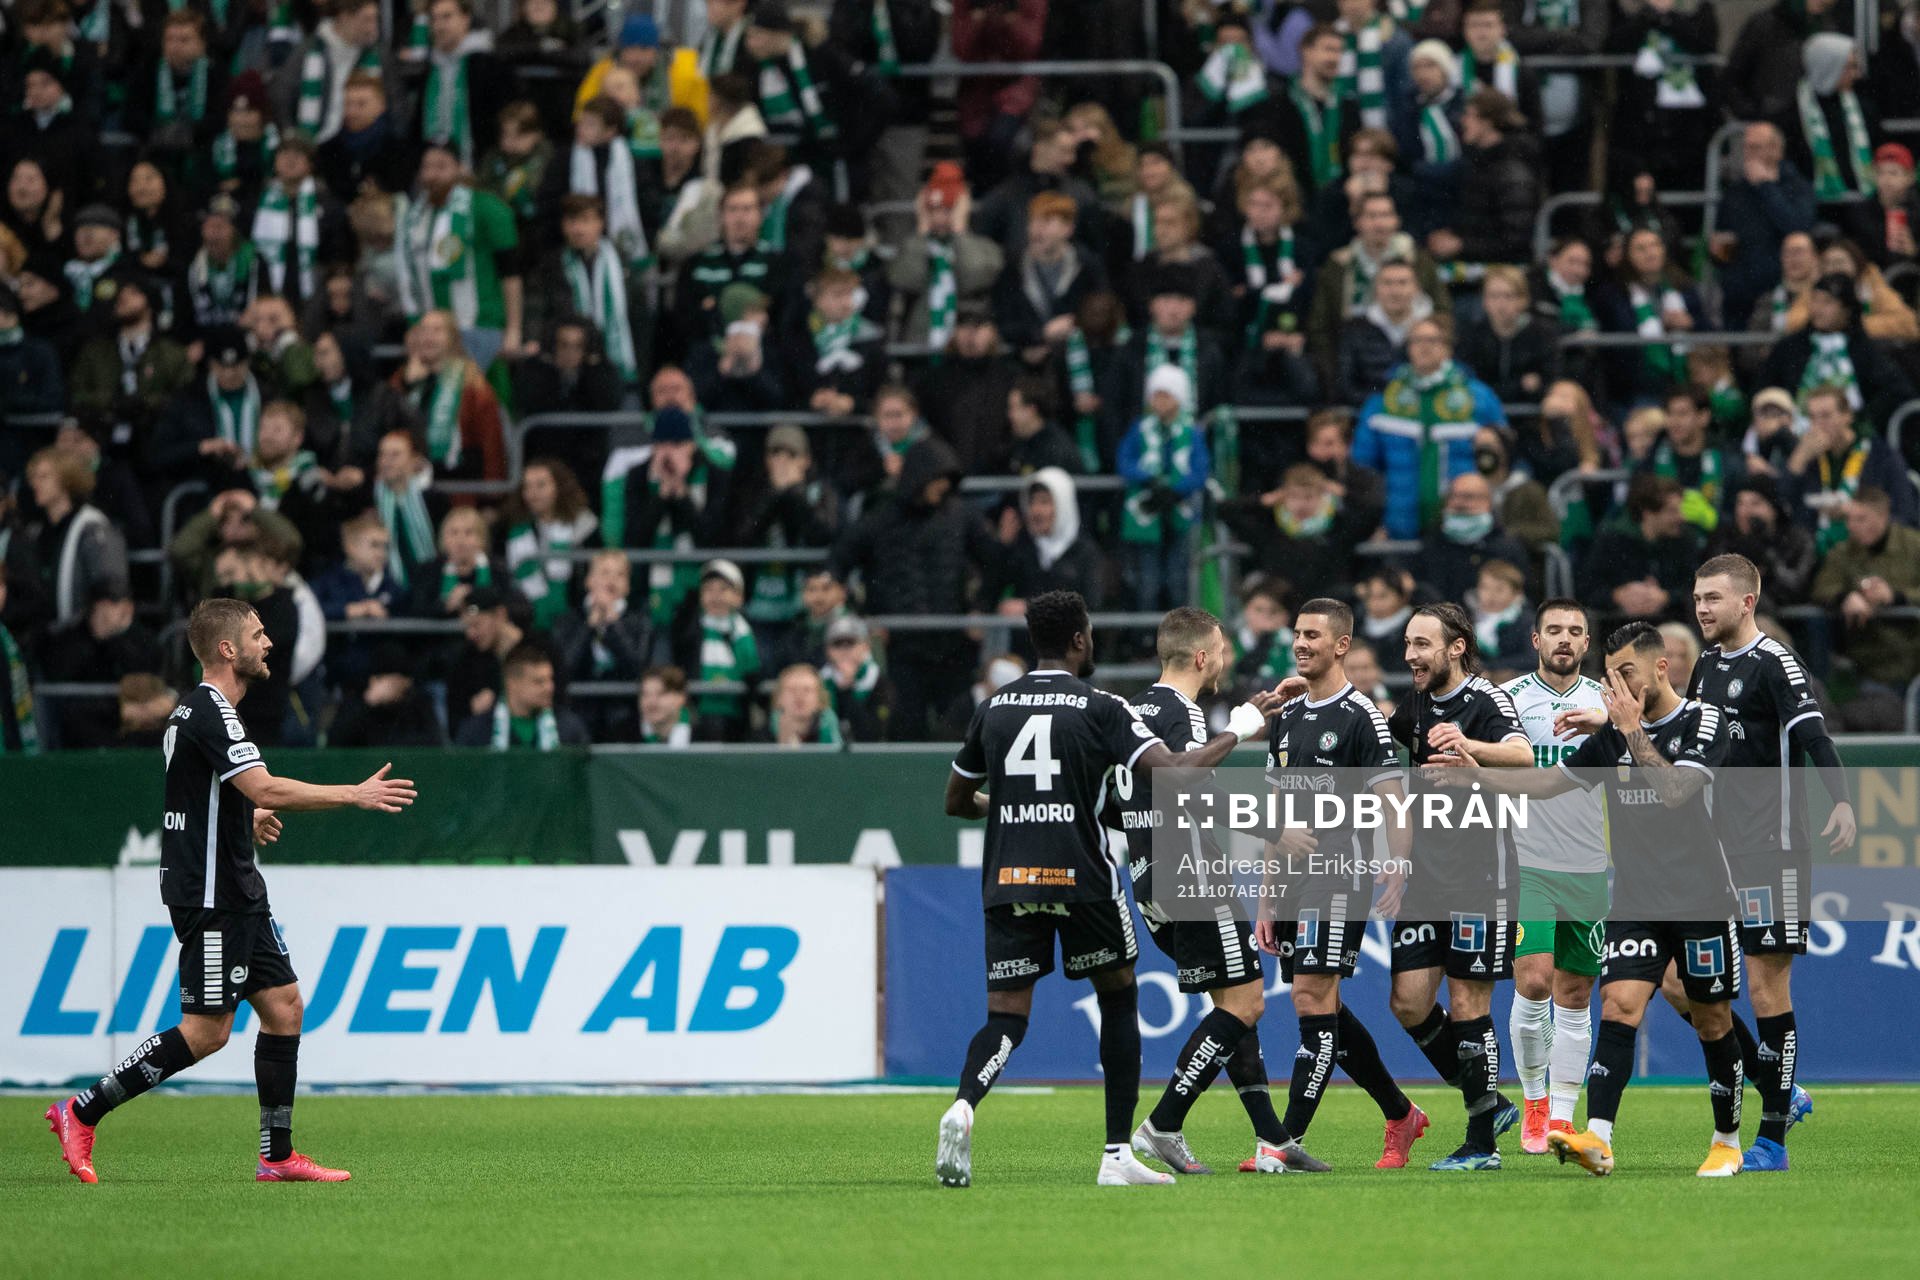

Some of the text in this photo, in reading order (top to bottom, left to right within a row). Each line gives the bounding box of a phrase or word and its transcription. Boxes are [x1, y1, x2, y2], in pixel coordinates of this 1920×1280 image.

[989, 693, 1088, 709] MALMBERGS
[1004, 714, 1062, 791] 4
[1000, 803, 1075, 824] N.MORO
[578, 924, 800, 1034] AB
[988, 963, 1040, 981] WELLNESS
[992, 957, 1032, 971] NORDIC
[1303, 1031, 1334, 1100] BRÖDERNAS
[1483, 1028, 1499, 1092] BRÖDERN
